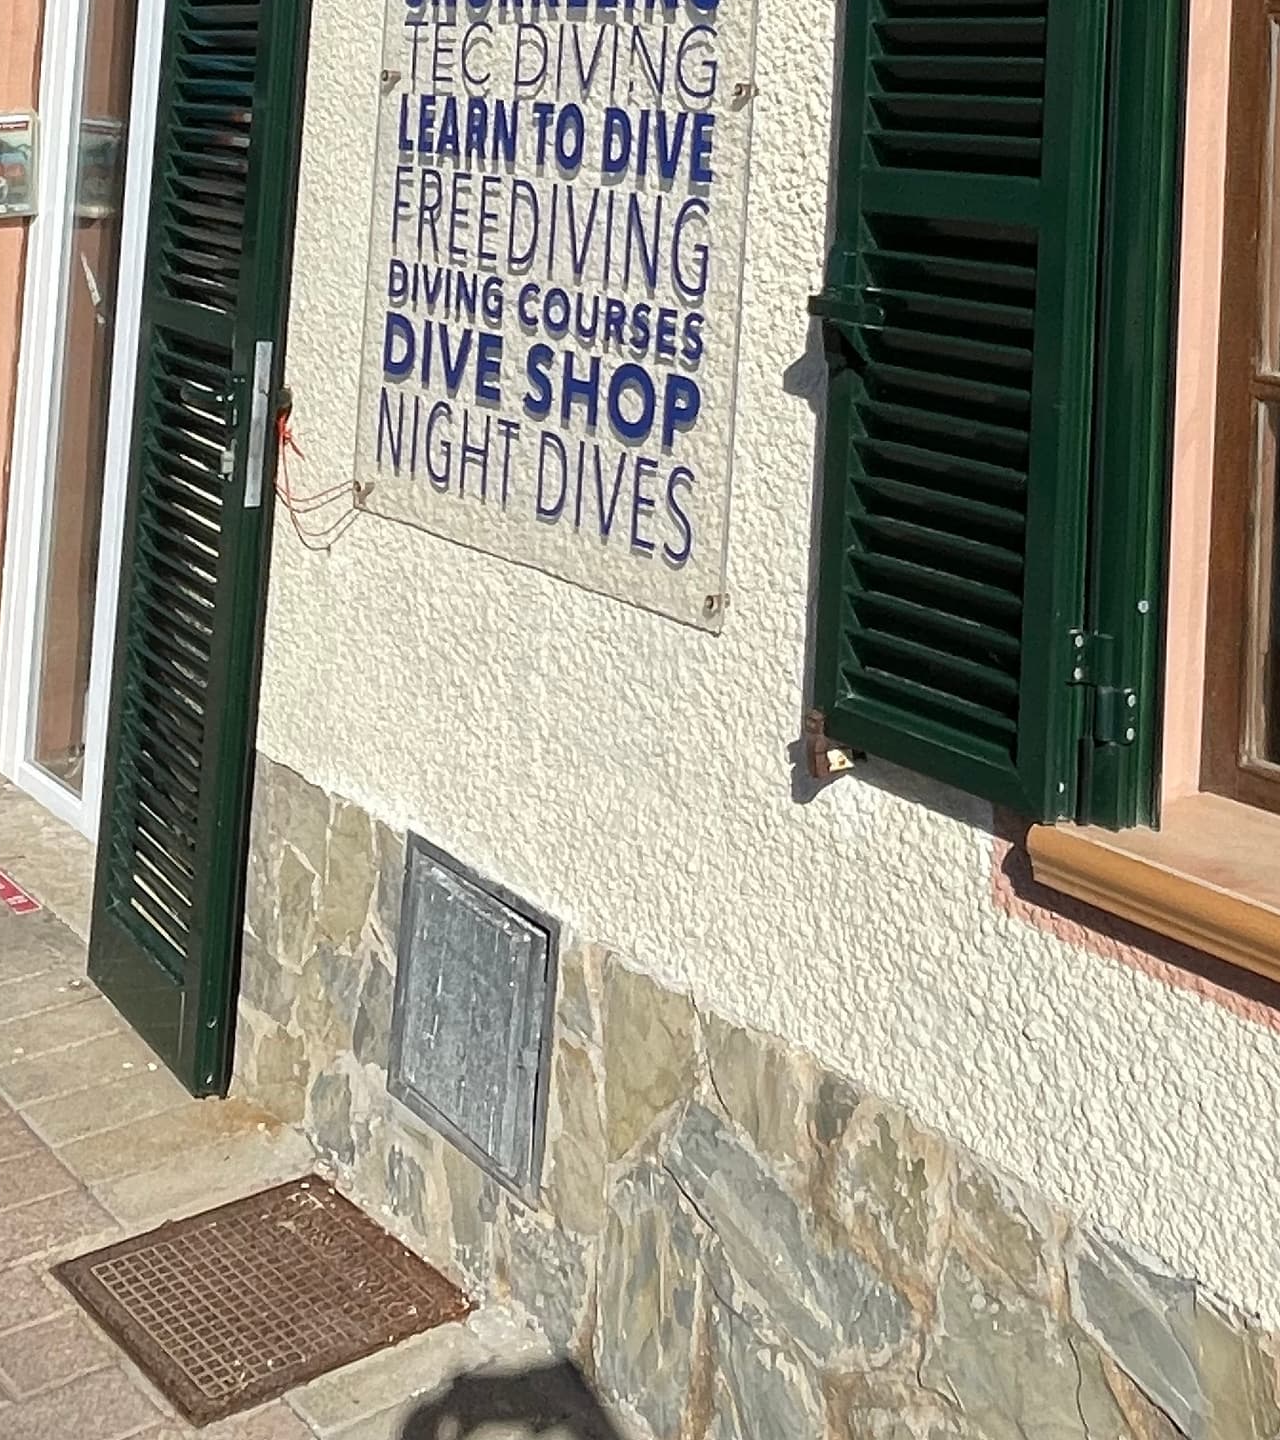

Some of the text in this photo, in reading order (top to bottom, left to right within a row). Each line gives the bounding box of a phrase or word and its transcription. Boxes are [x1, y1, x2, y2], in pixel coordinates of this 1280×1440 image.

[404, 20, 719, 98] TEC DIVING
[398, 93, 716, 183] LEARN TO DIVE
[391, 165, 709, 297] FREEDIVING
[387, 259, 706, 361] DIVING COURSES
[383, 311, 702, 447] DIVE SHOP
[376, 386, 696, 563] NIGHT DIVES
